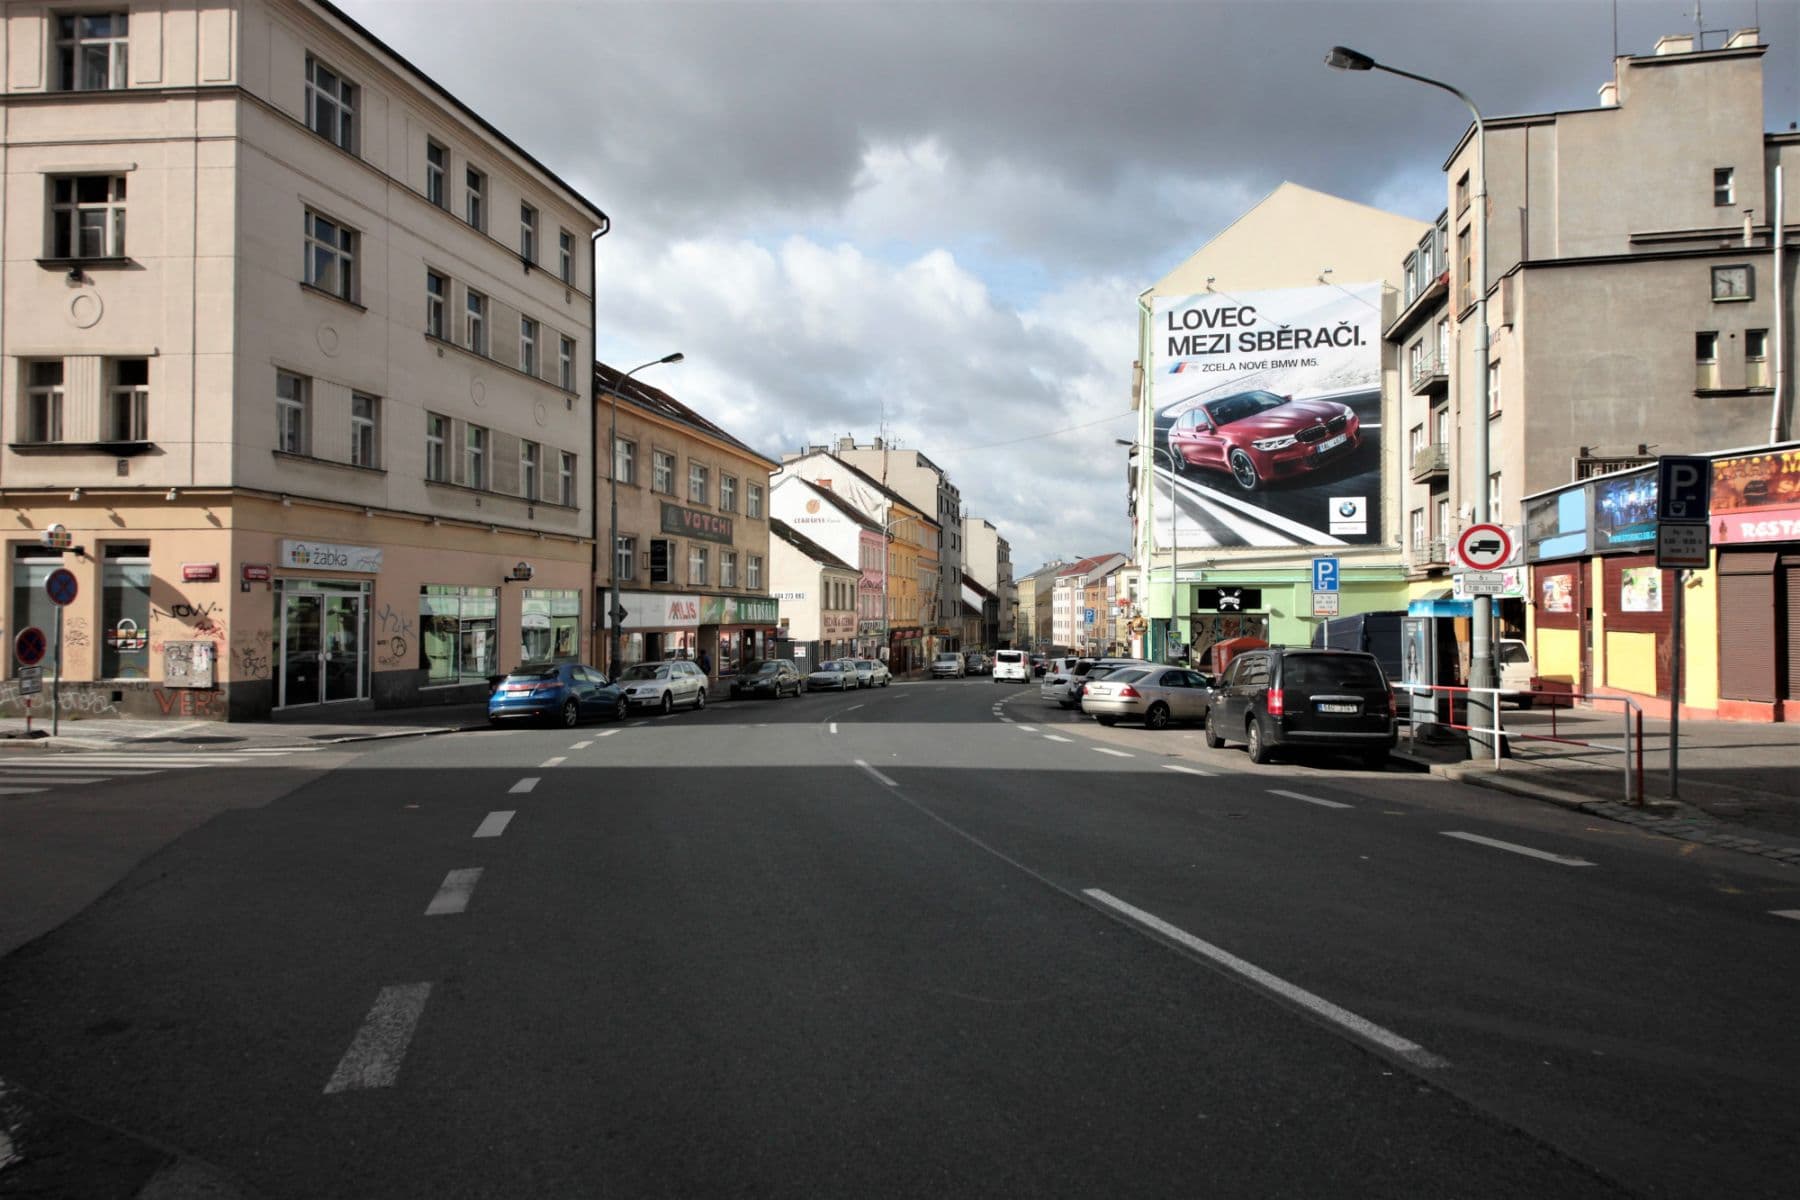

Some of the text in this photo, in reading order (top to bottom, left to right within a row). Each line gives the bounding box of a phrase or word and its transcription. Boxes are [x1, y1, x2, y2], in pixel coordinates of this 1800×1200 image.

[1168, 306, 1256, 331] LOVEC
[1168, 320, 1366, 356] MEZI SBĚRAČI.
[1202, 358, 1319, 373] ZCELA NOVÉ BMW M5.
[1670, 464, 1699, 500] P
[313, 547, 348, 567] žabka
[1318, 562, 1333, 582] P
